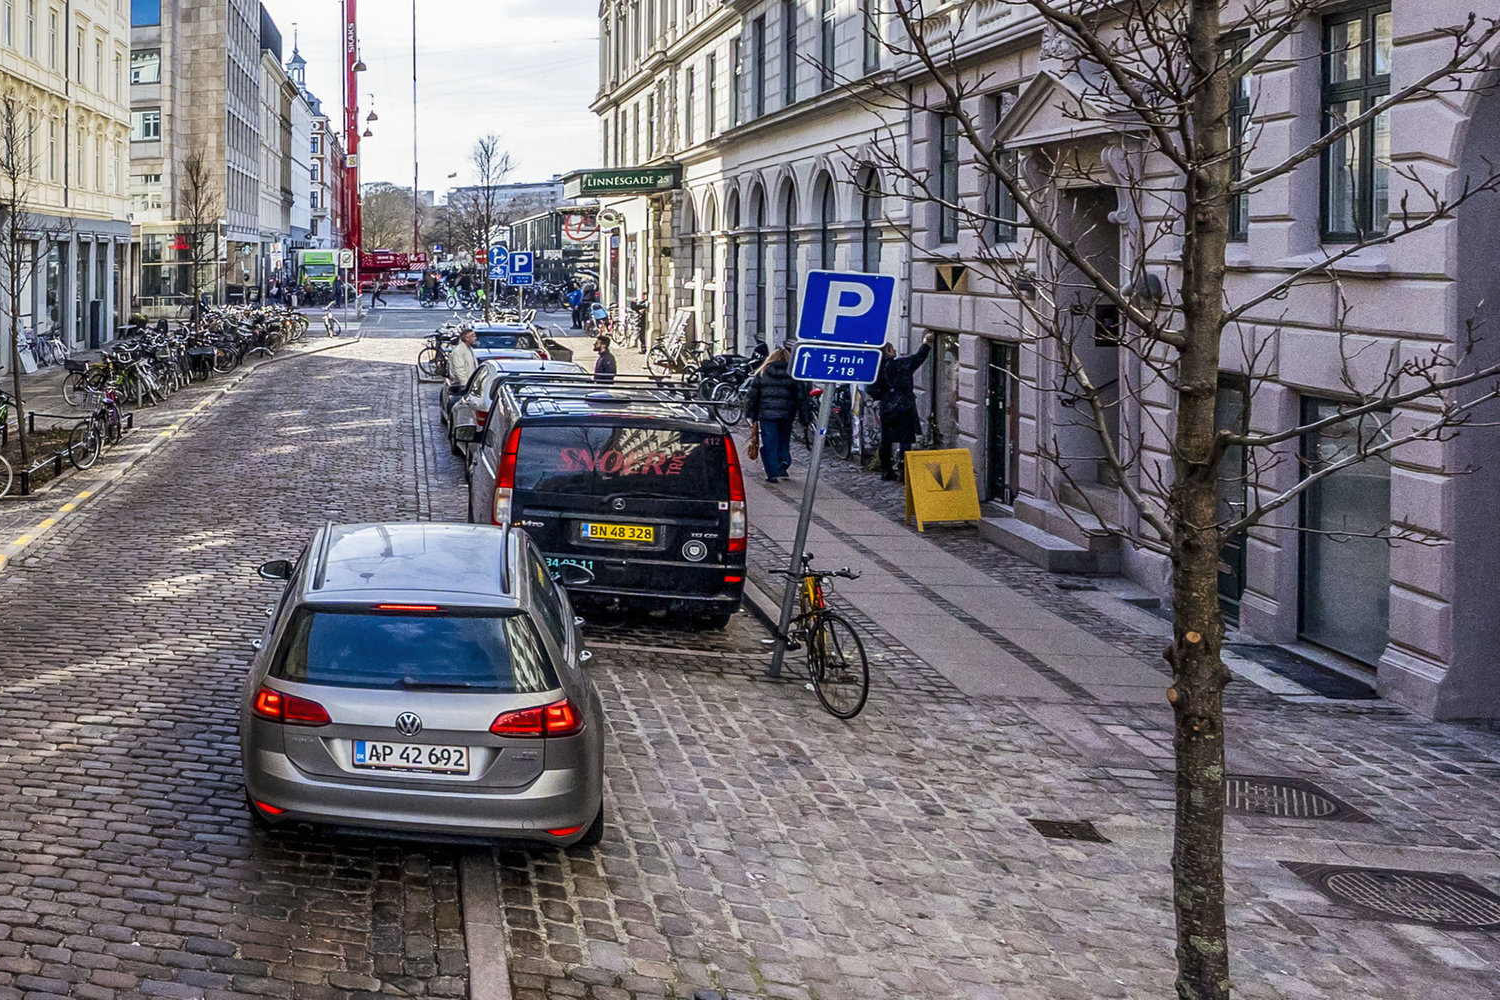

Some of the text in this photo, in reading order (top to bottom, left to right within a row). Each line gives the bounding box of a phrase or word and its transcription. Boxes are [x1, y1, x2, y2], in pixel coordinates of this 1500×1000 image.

[587, 175, 670, 187] LINNÉSGADE 25
[514, 254, 529, 272] P
[821, 280, 875, 335] P
[822, 354, 865, 365] 15 min
[827, 366, 855, 376] 7-18
[590, 525, 607, 536] BN
[610, 526, 626, 538] 48
[628, 527, 652, 539] 328
[368, 743, 393, 762] AP
[399, 746, 423, 765] 42
[427, 747, 465, 767] 692
